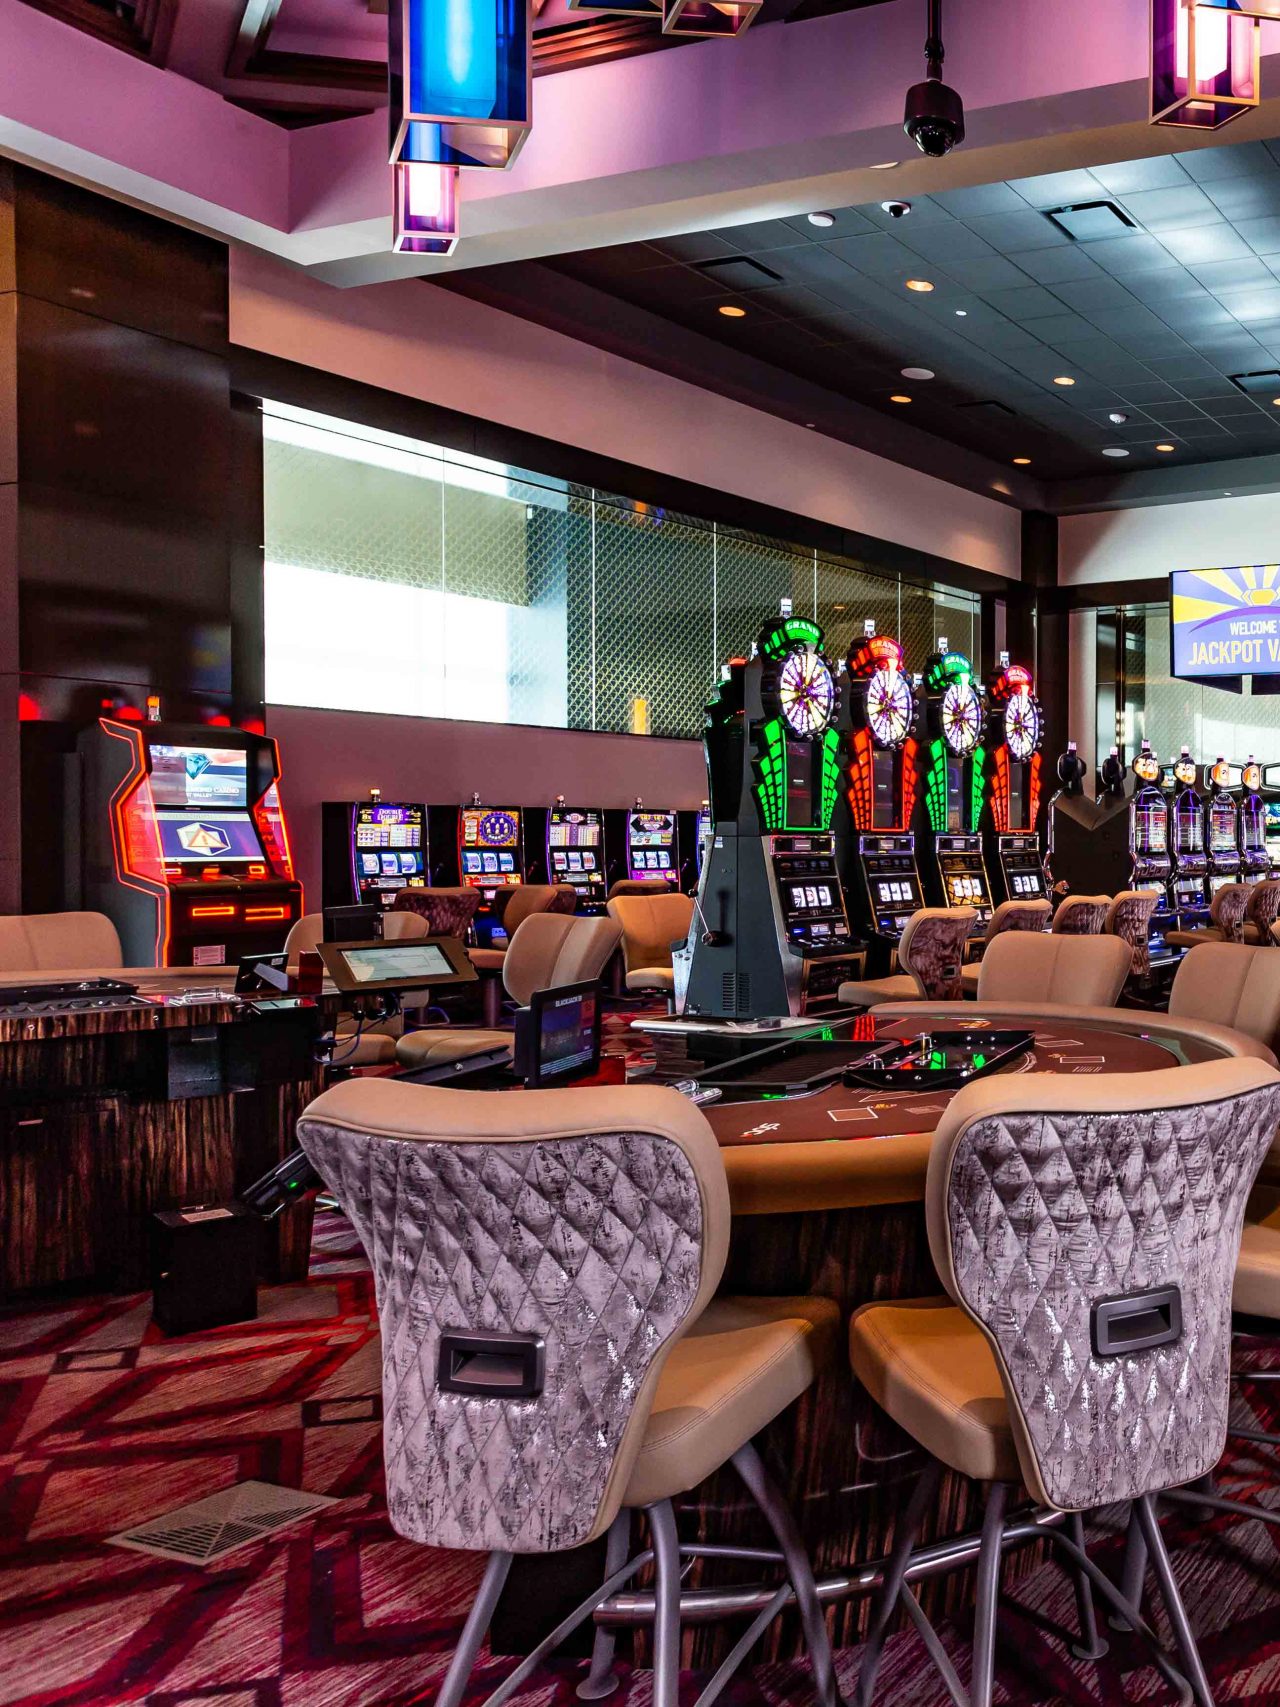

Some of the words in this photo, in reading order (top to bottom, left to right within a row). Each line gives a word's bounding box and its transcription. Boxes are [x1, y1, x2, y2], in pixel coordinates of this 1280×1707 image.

[785, 620, 820, 637] GRAND
[1230, 620, 1277, 636] WELCOME
[1188, 640, 1264, 666] JACKPOT
